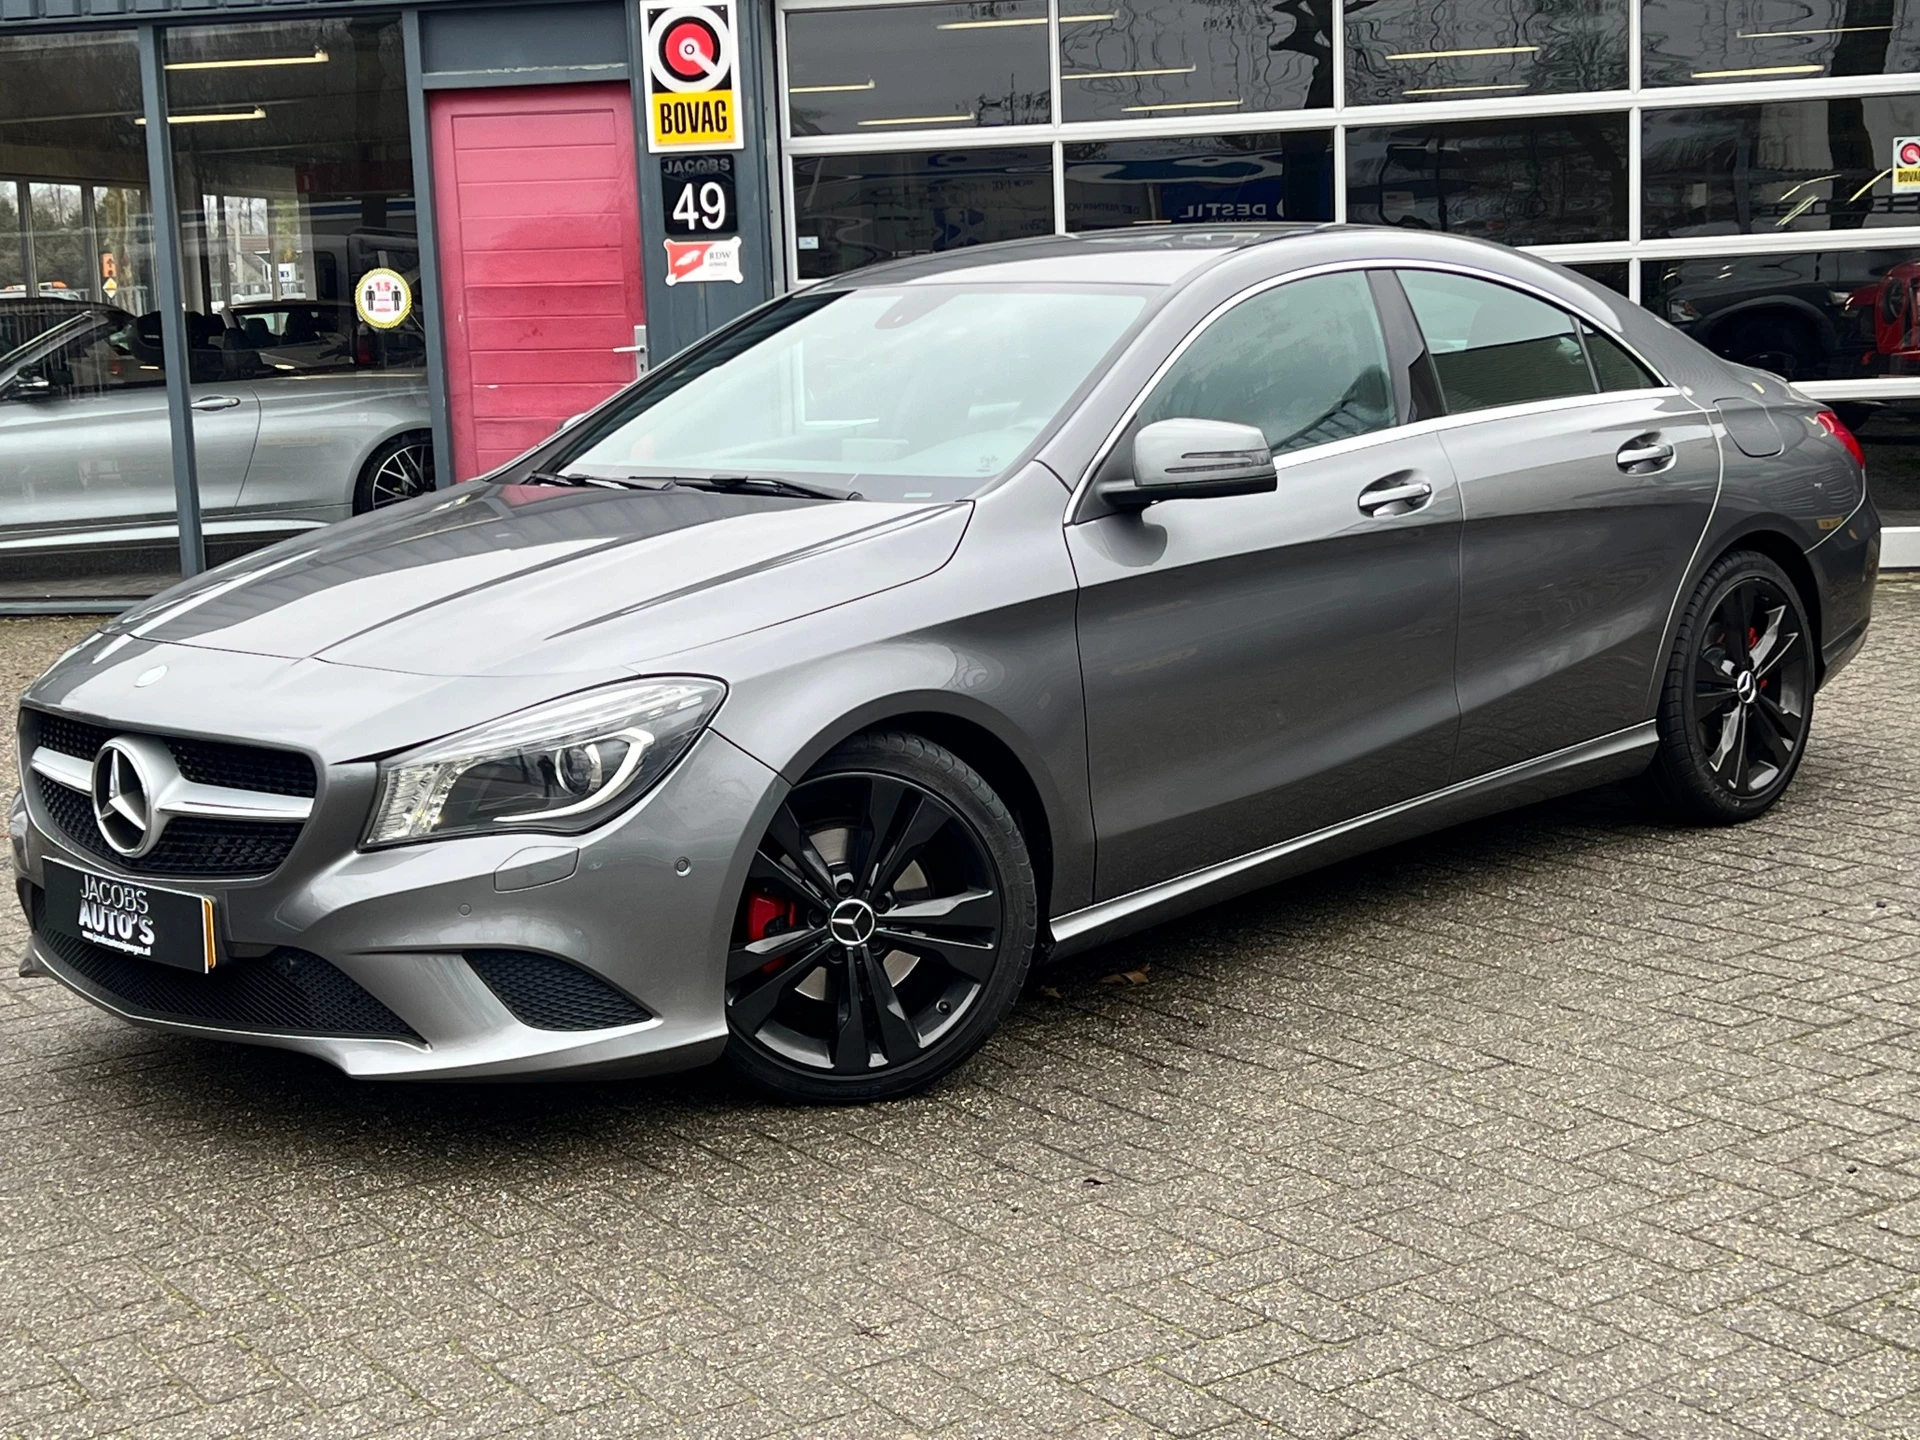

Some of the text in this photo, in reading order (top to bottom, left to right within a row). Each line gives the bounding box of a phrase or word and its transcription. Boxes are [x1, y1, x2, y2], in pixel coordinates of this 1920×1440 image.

[660, 100, 727, 135] BOVAG
[663, 158, 730, 174] JACOBS
[672, 181, 726, 230] 49
[708, 250, 732, 260] RDW
[80, 874, 149, 914] JACOBS
[78, 899, 155, 945] AUTO'S
